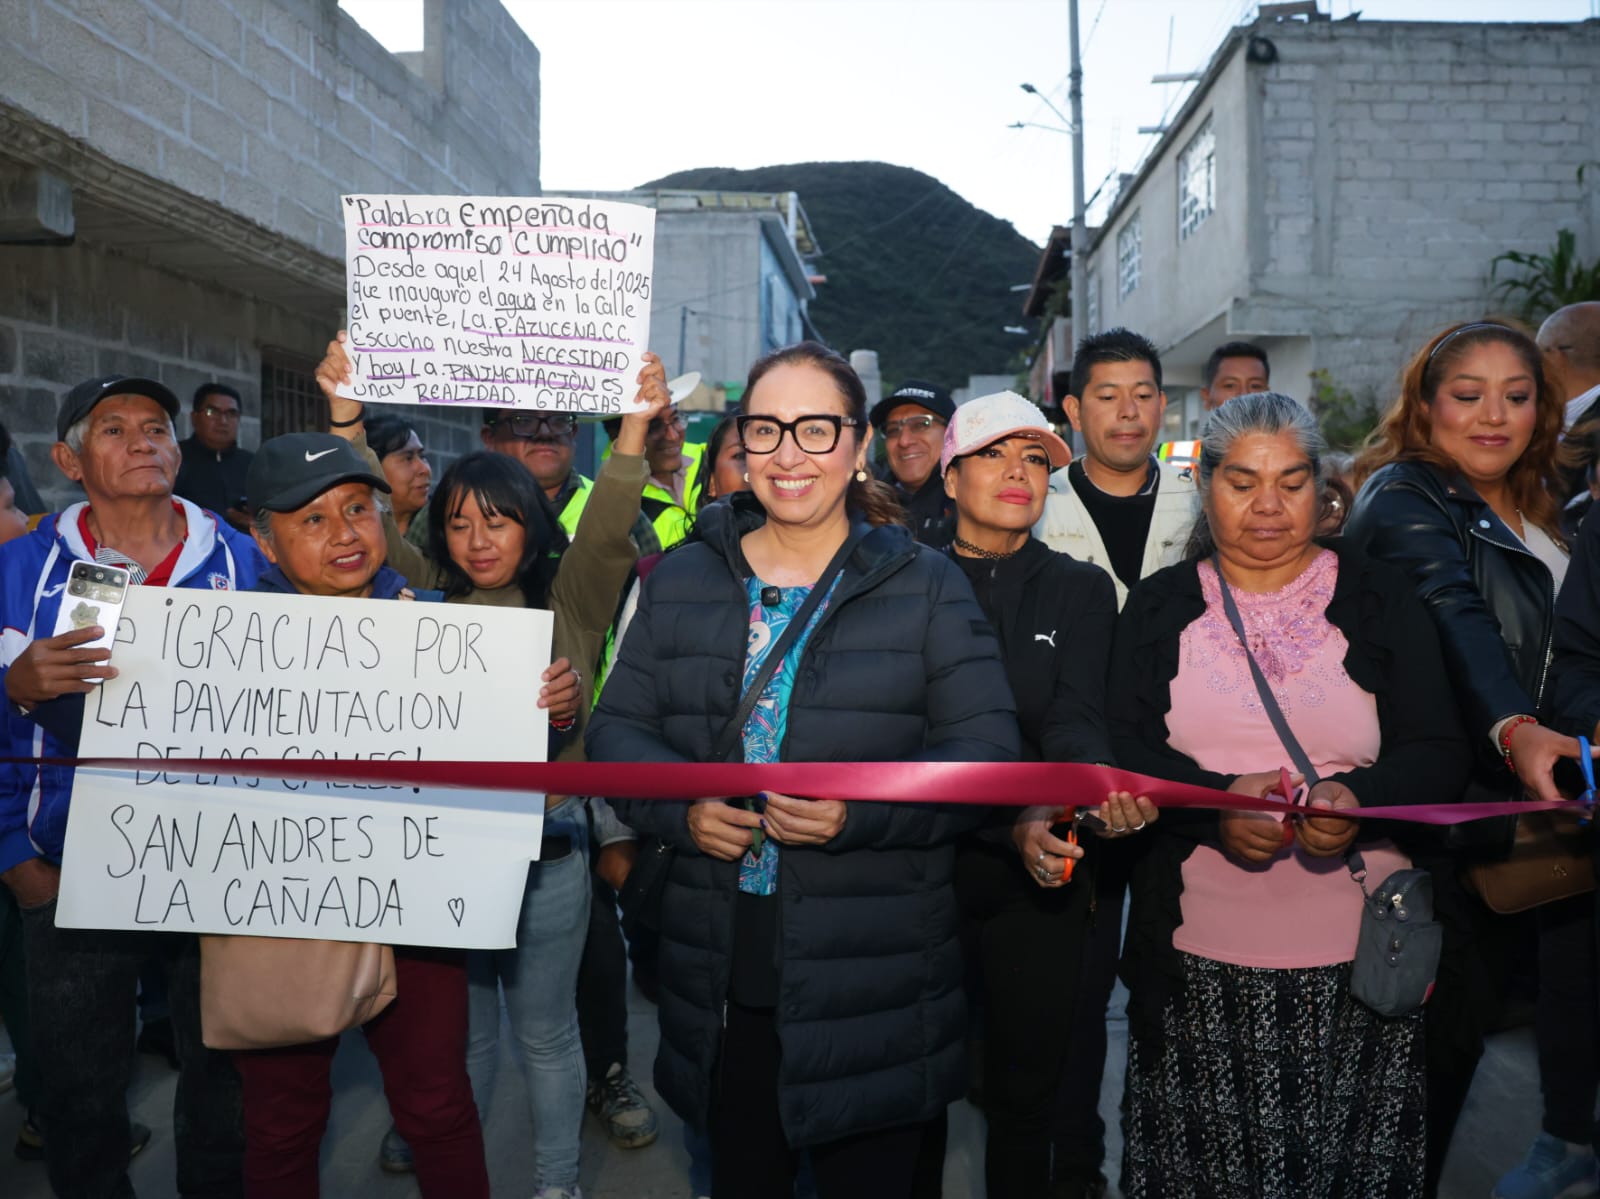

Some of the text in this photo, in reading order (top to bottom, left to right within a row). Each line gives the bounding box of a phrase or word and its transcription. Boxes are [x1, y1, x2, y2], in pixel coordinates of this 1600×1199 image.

[353, 252, 650, 299] Desde aquel 24 Agosto del 2025
[352, 281, 382, 302] que
[479, 286, 494, 306] el
[543, 299, 565, 312] en
[576, 294, 590, 315] la
[352, 303, 369, 320] el
[379, 305, 456, 329] puente,
[444, 334, 512, 357] nuestra
[521, 339, 630, 370] NECESIDAD
[369, 354, 405, 390] hoy
[602, 378, 624, 395] es
[354, 383, 393, 398] una
[536, 389, 622, 413] GRACIAS
[413, 617, 488, 679] POR
[95, 679, 463, 738] LA PAVIMENTACION
[107, 804, 445, 879] SAN ANDRES DE
[133, 874, 404, 929] LA CAÑADA
